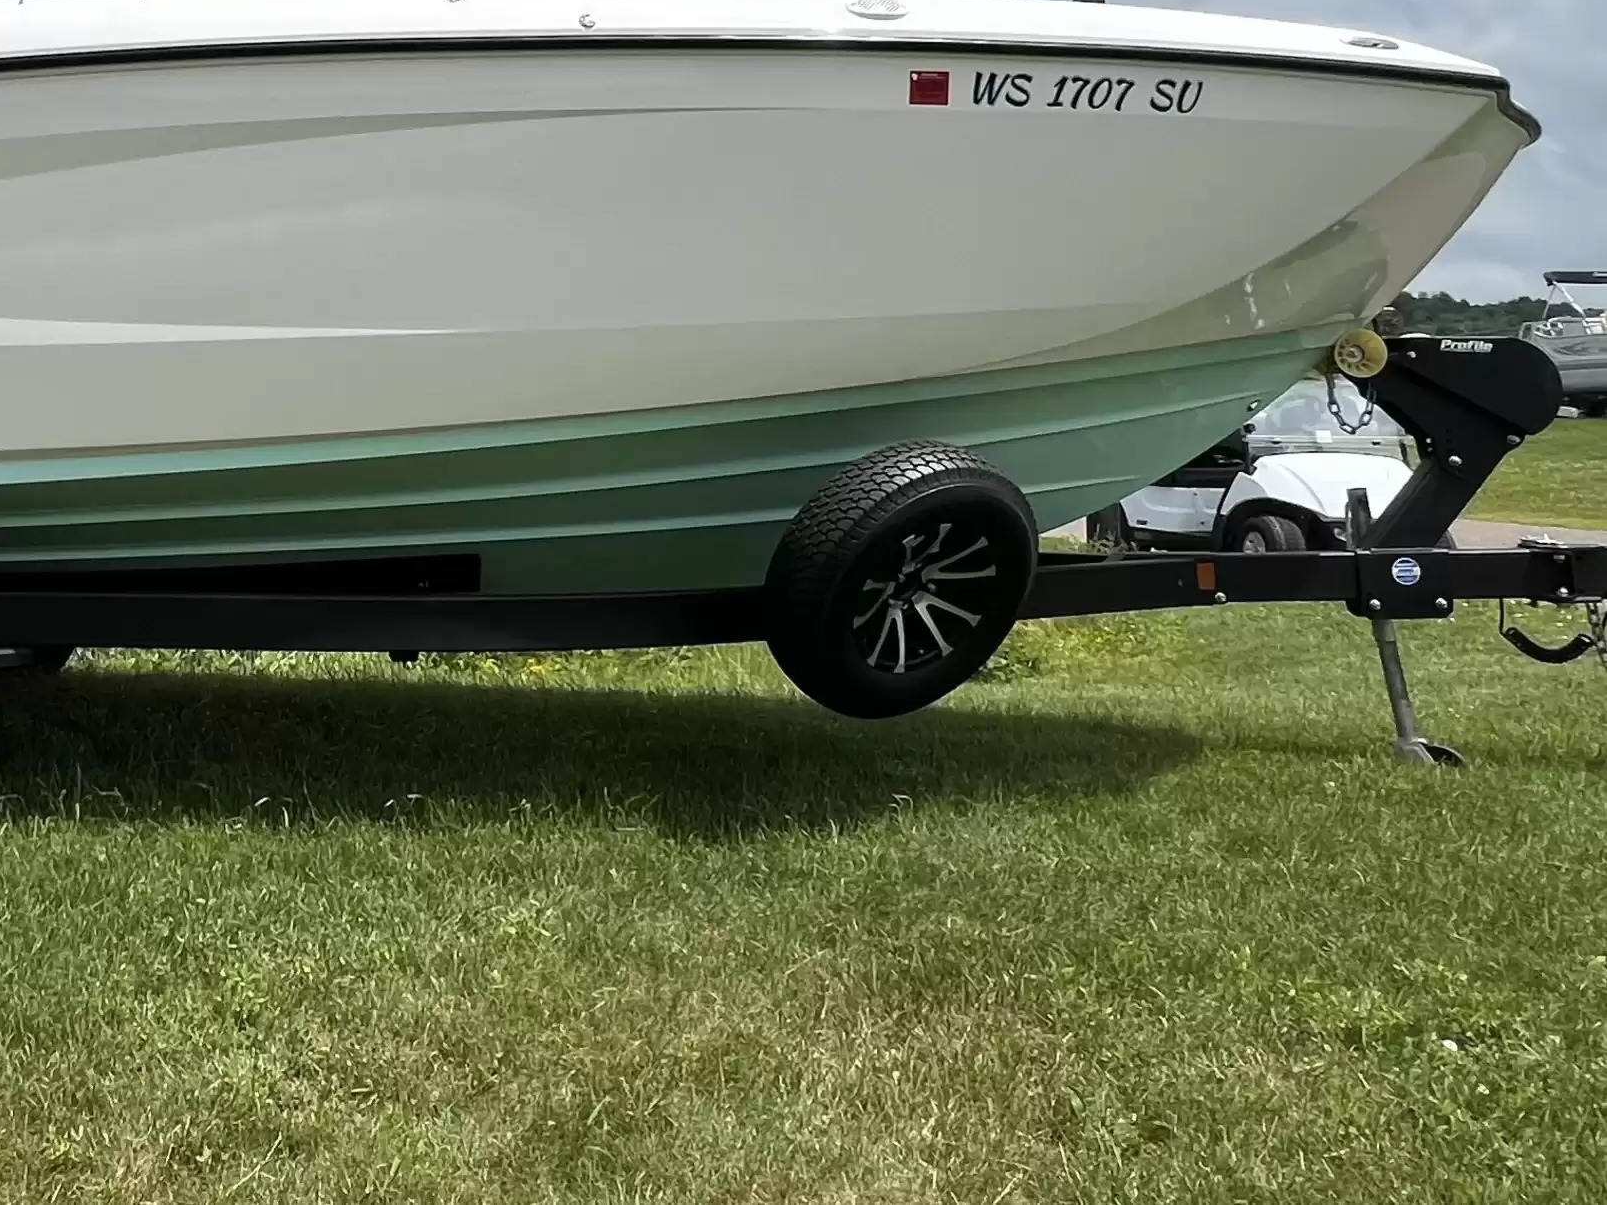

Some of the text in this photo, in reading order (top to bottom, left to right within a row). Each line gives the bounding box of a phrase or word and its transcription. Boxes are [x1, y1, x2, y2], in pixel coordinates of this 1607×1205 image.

[972, 71, 1033, 107] WS
[1046, 75, 1135, 112] 1707
[1149, 79, 1204, 114] SU
